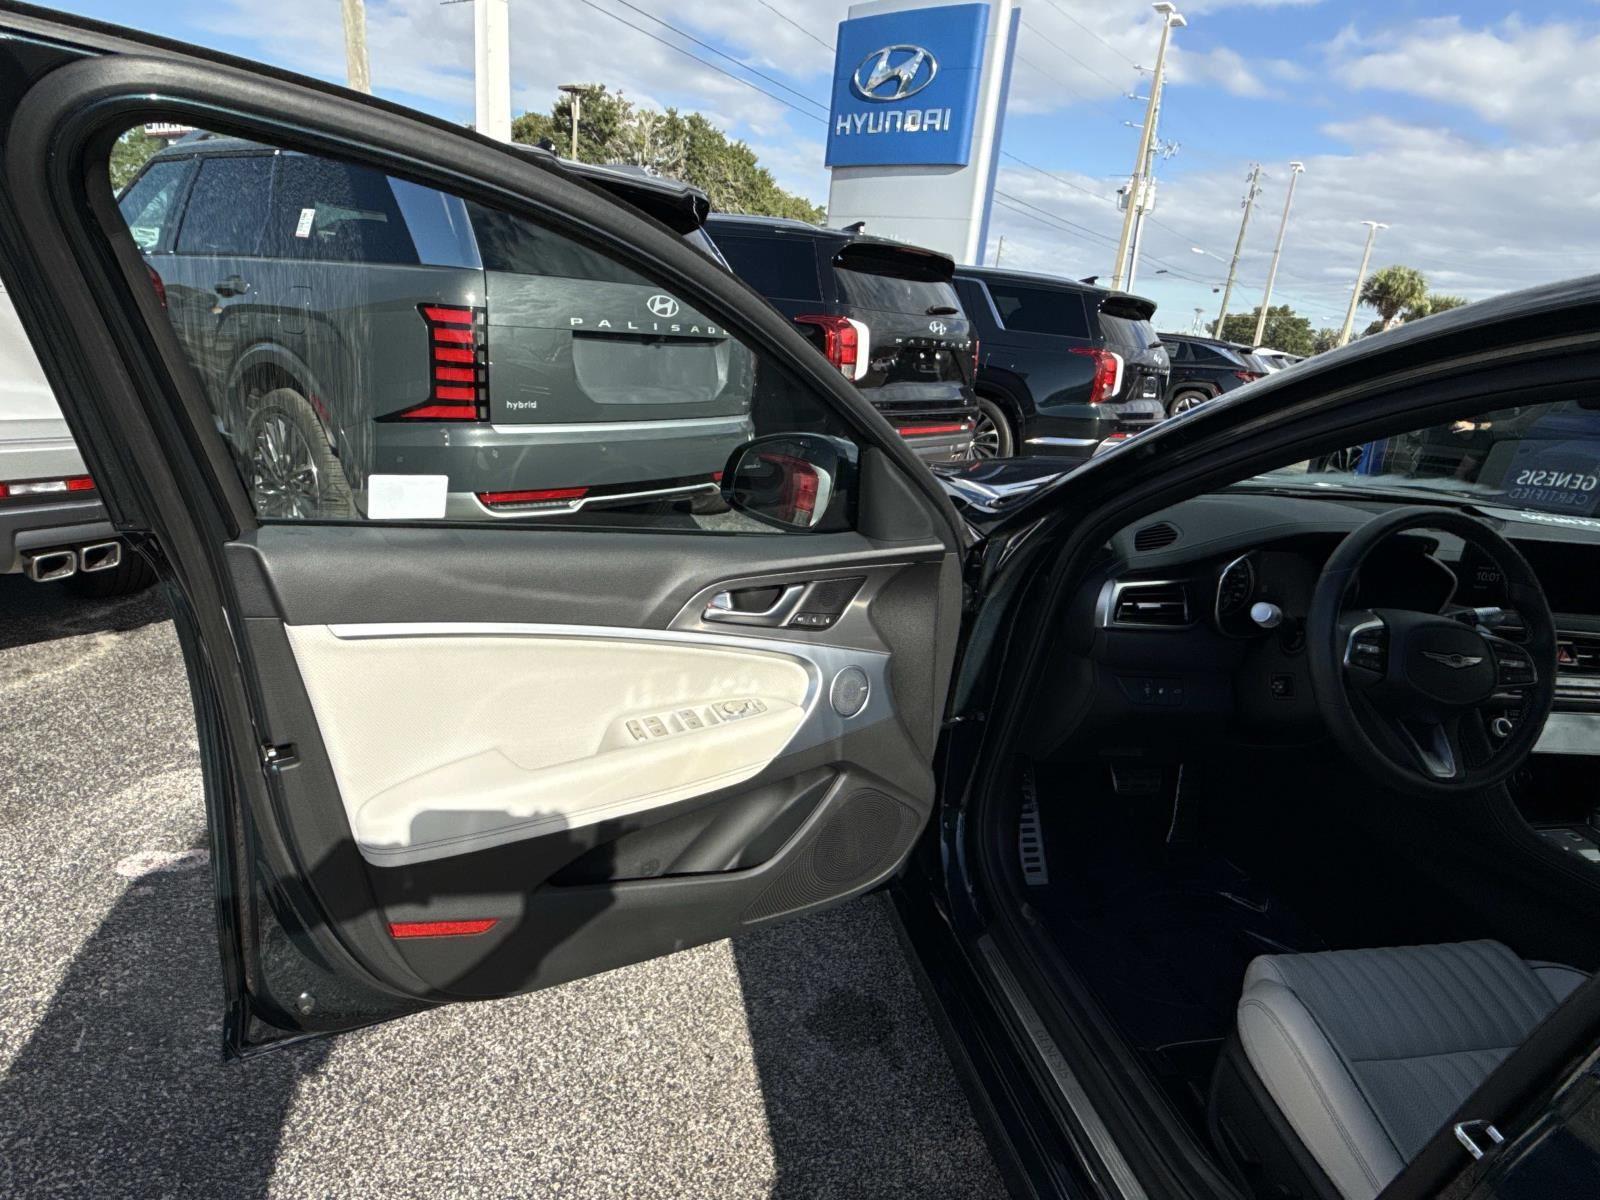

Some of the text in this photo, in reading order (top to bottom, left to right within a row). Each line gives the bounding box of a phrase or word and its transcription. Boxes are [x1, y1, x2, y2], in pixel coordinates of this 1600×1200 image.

[836, 108, 951, 136] HYUNDAI
[506, 400, 537, 411] hybrid
[1036, 1030, 1070, 1079] GENESIS
